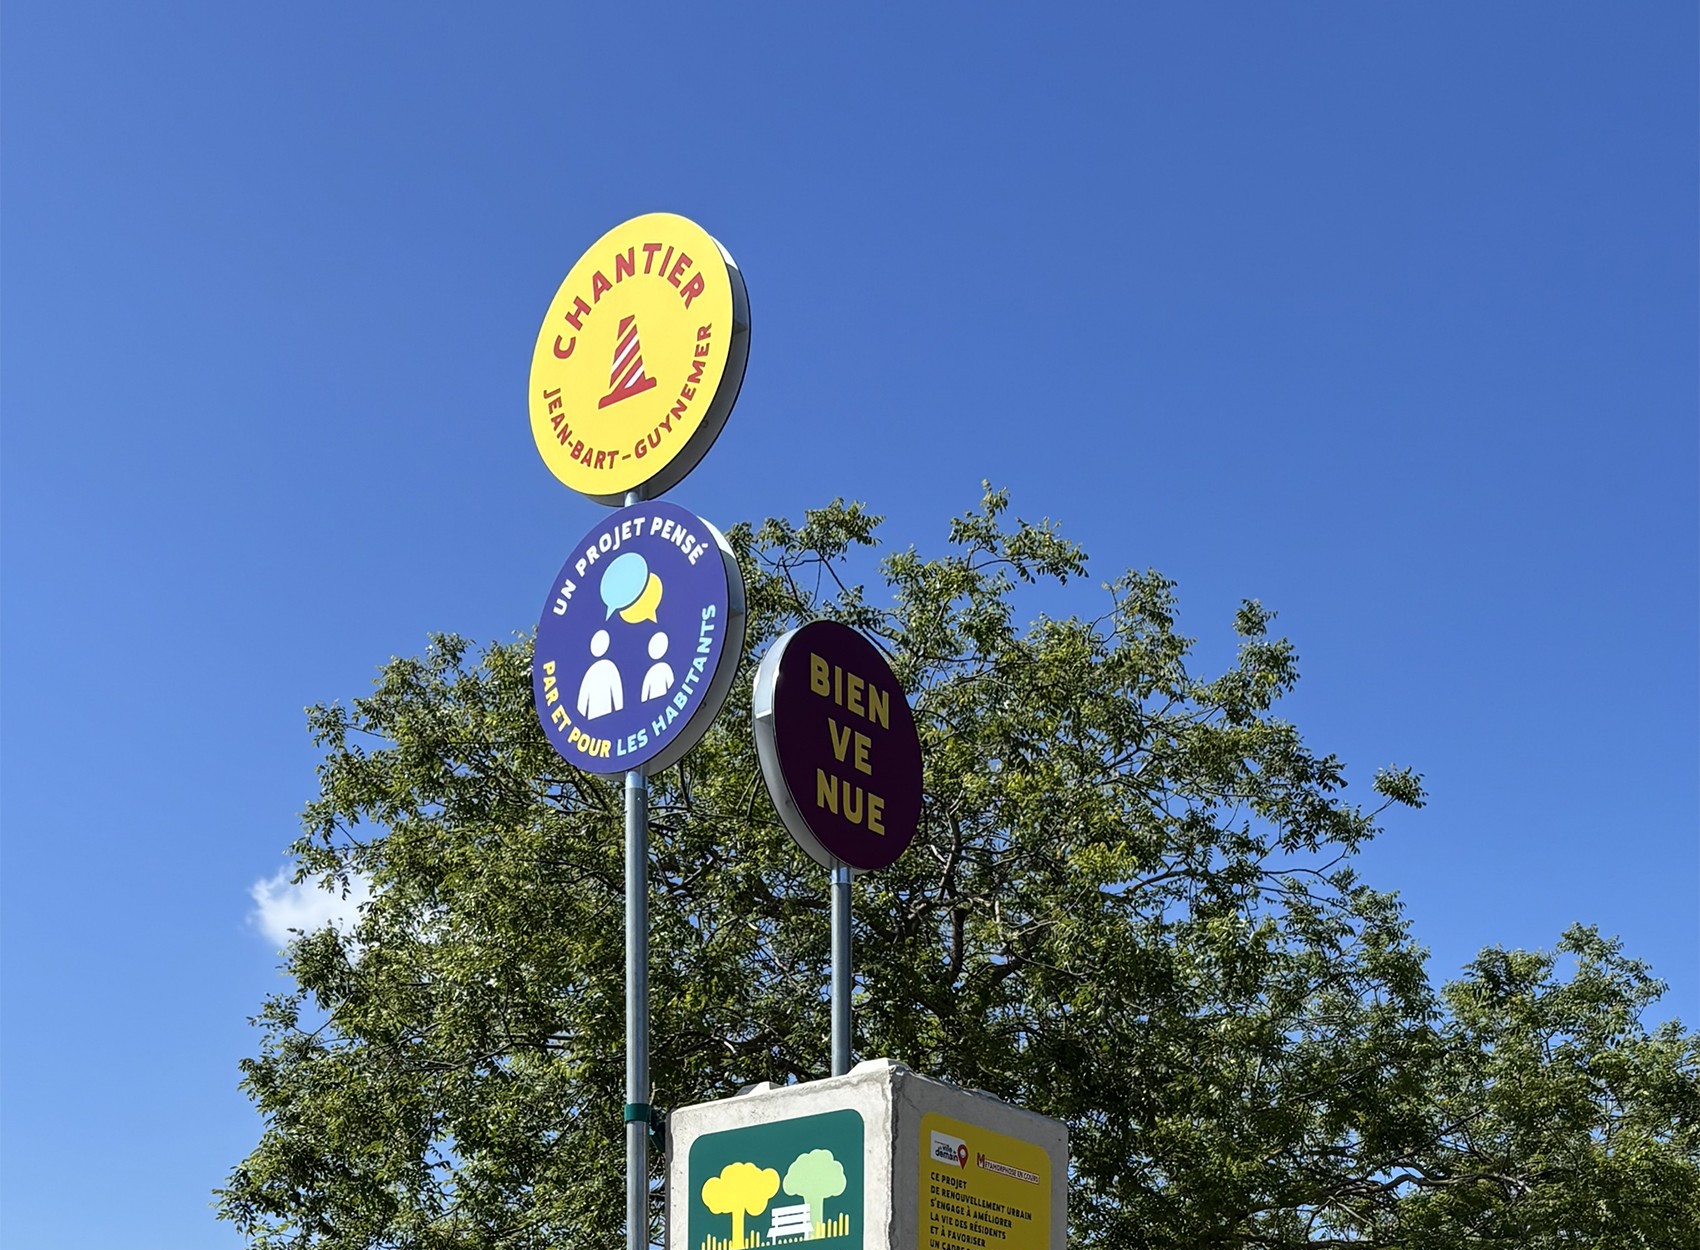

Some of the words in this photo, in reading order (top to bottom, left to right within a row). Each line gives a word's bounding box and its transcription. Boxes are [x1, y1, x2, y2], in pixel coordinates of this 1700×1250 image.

[553, 243, 705, 359] CHANTIER
[553, 579, 577, 616] UN
[575, 516, 646, 577] PROJET
[650, 516, 709, 565] PENSÉ
[543, 660, 559, 706] PAR
[551, 704, 572, 732] ET
[567, 727, 612, 758] POUR
[616, 728, 649, 757] LES
[651, 604, 716, 737] HABITANTS
[810, 652, 889, 730] BIEN
[828, 717, 872, 776] VE
[817, 767, 885, 836] NUE
[930, 1171, 940, 1182] CE
[941, 1176, 967, 1190] PROJET
[930, 1185, 940, 1195] DE
[941, 1190, 1005, 1214] RENOUVELLEMENT
[1007, 1206, 1032, 1220] URBAIN
[930, 1198, 965, 1214] S'ENGAGE
[966, 1206, 971, 1217] À
[973, 1211, 1012, 1229] AMÉLIORER
[930, 1212, 939, 1222] LA
[941, 1215, 953, 1226] VIE
[954, 1219, 967, 1230] DES
[969, 1221, 1006, 1239] RÉSIDENTS
[930, 1225, 939, 1235] ET
[941, 1227, 946, 1237] À
[948, 1230, 986, 1247] FAVORISER
[930, 1239, 940, 1249] UN
